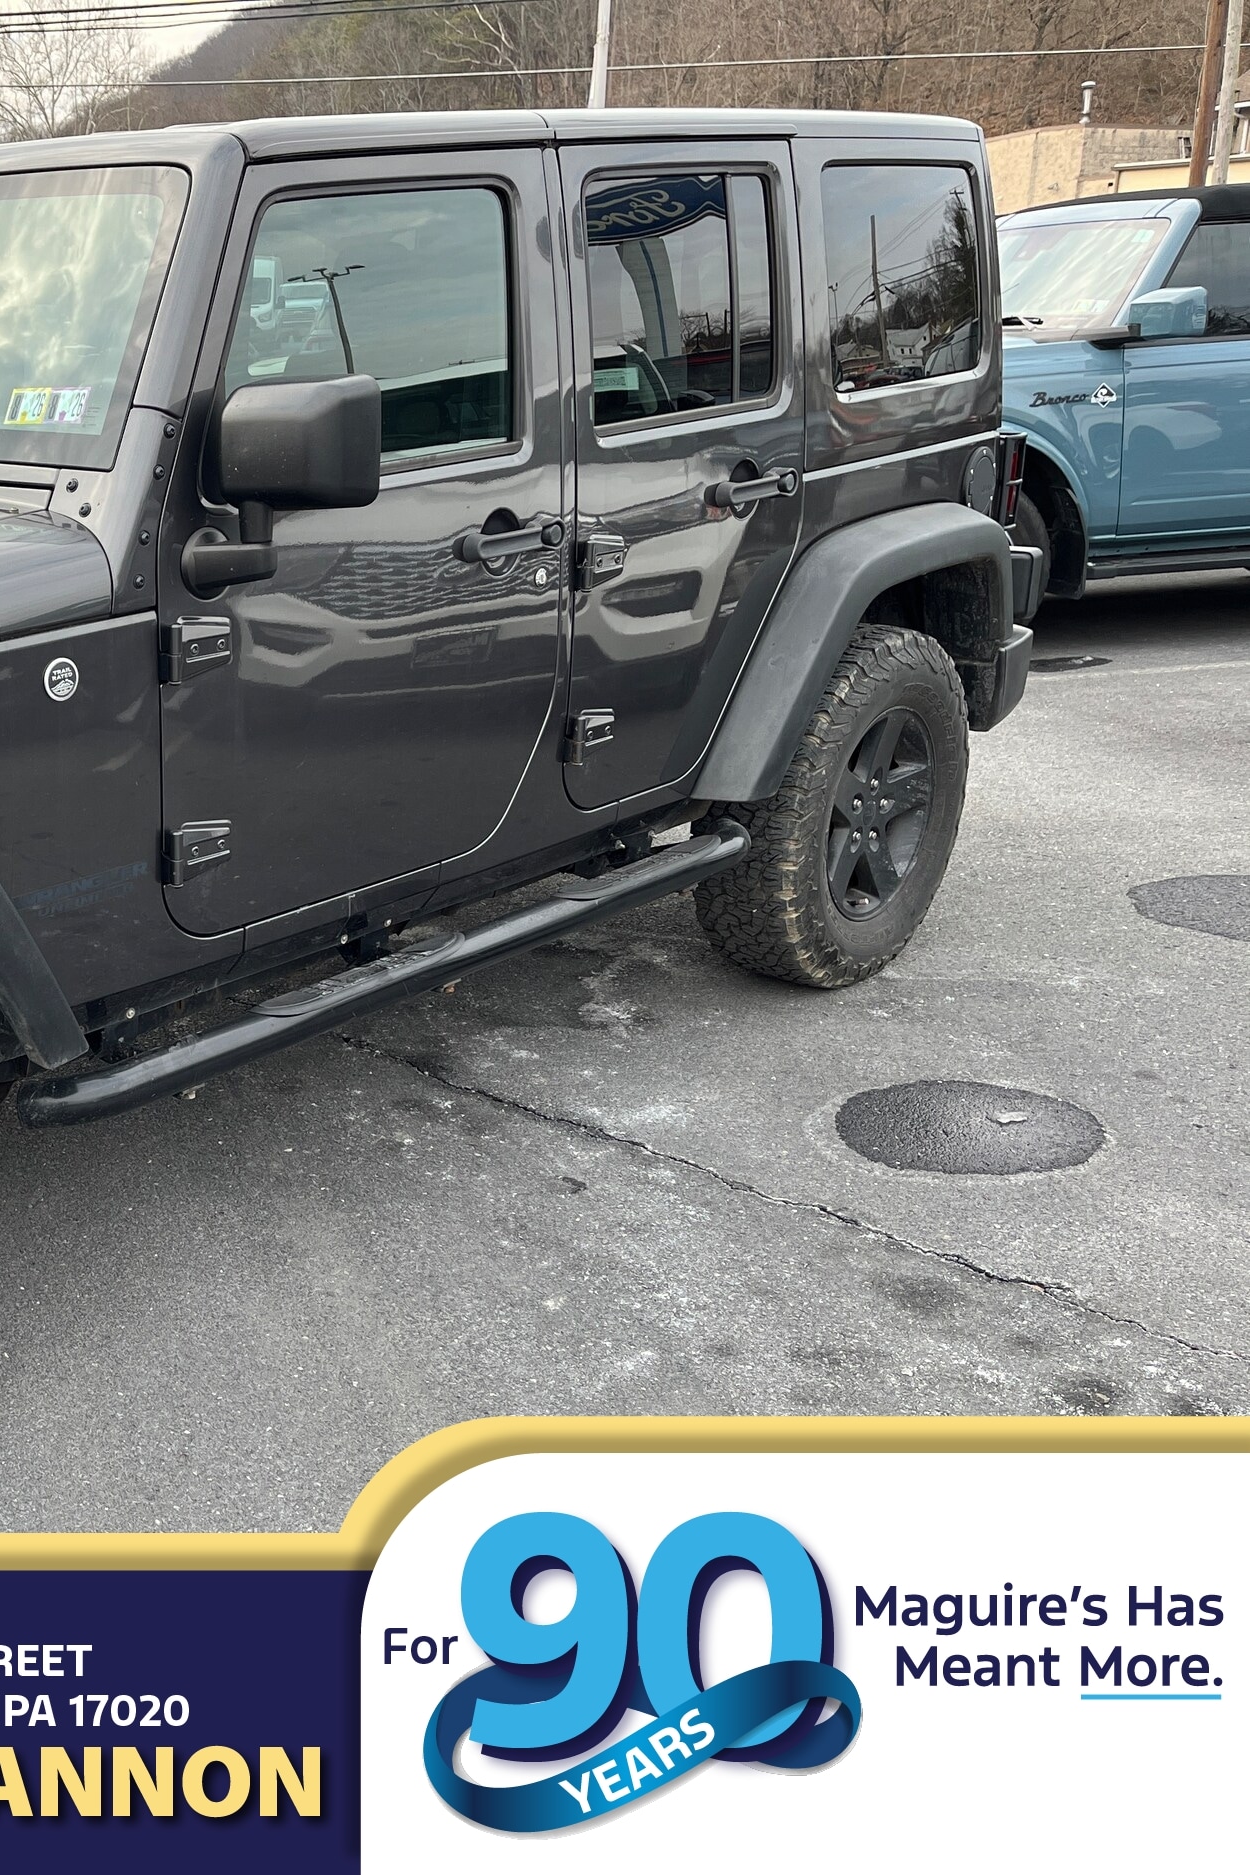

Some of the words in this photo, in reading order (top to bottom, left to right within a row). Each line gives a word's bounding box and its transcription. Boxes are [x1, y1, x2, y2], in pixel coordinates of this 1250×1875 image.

[1029, 391, 1090, 408] Bronco
[52, 667, 72, 676] TRAIL
[51, 672, 73, 682] RATED
